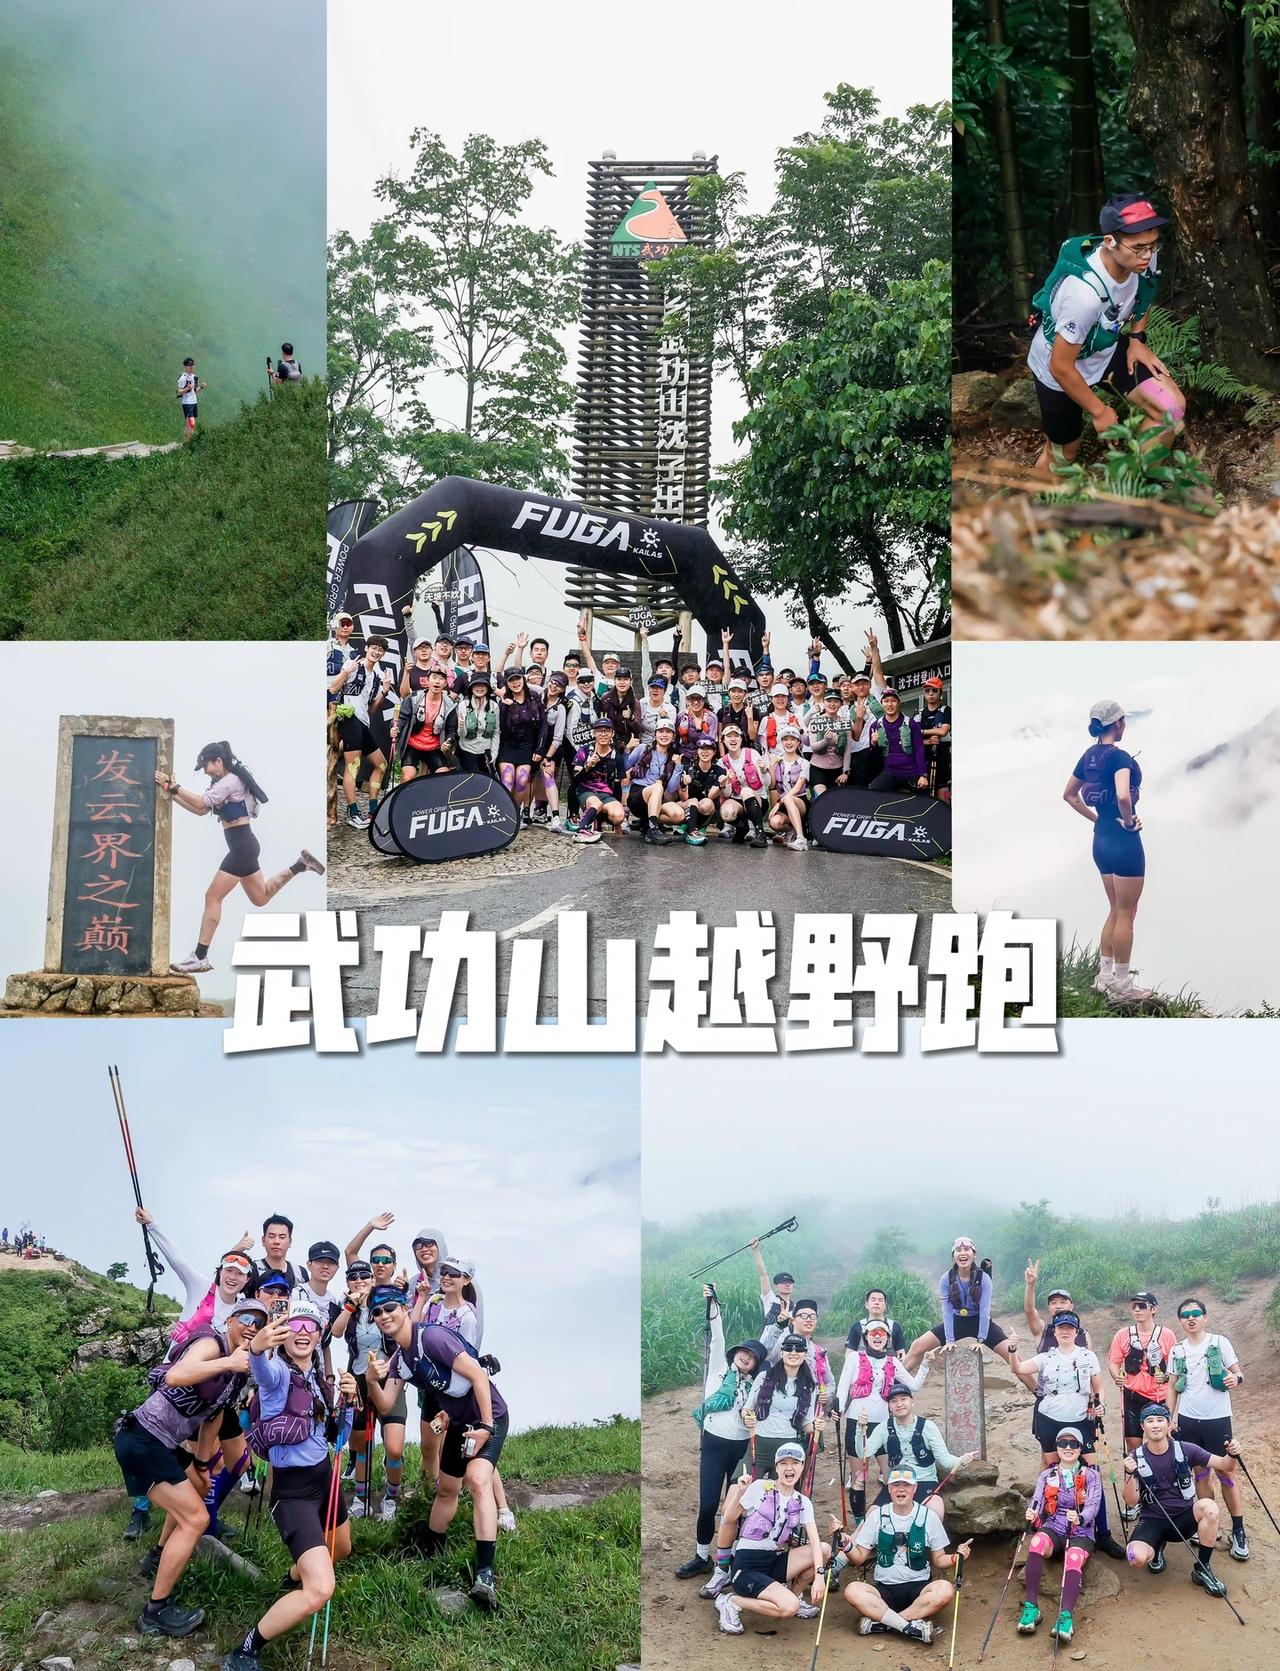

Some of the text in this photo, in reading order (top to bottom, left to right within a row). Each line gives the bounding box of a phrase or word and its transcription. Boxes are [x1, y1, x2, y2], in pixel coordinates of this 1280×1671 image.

[612, 243, 679, 258] NTS 武功
[511, 501, 630, 552] FUGA
[333, 543, 350, 582] POWER
[633, 547, 663, 559] KAILAS
[328, 583, 340, 610] GRIP
[629, 611, 653, 621] FUGA
[634, 619, 657, 629] YYDS
[409, 806, 484, 839] FUGA
[412, 806, 448, 817] POWER GRIP
[822, 817, 906, 841] FUGA
[72, 750, 143, 956] 发云界之巅
